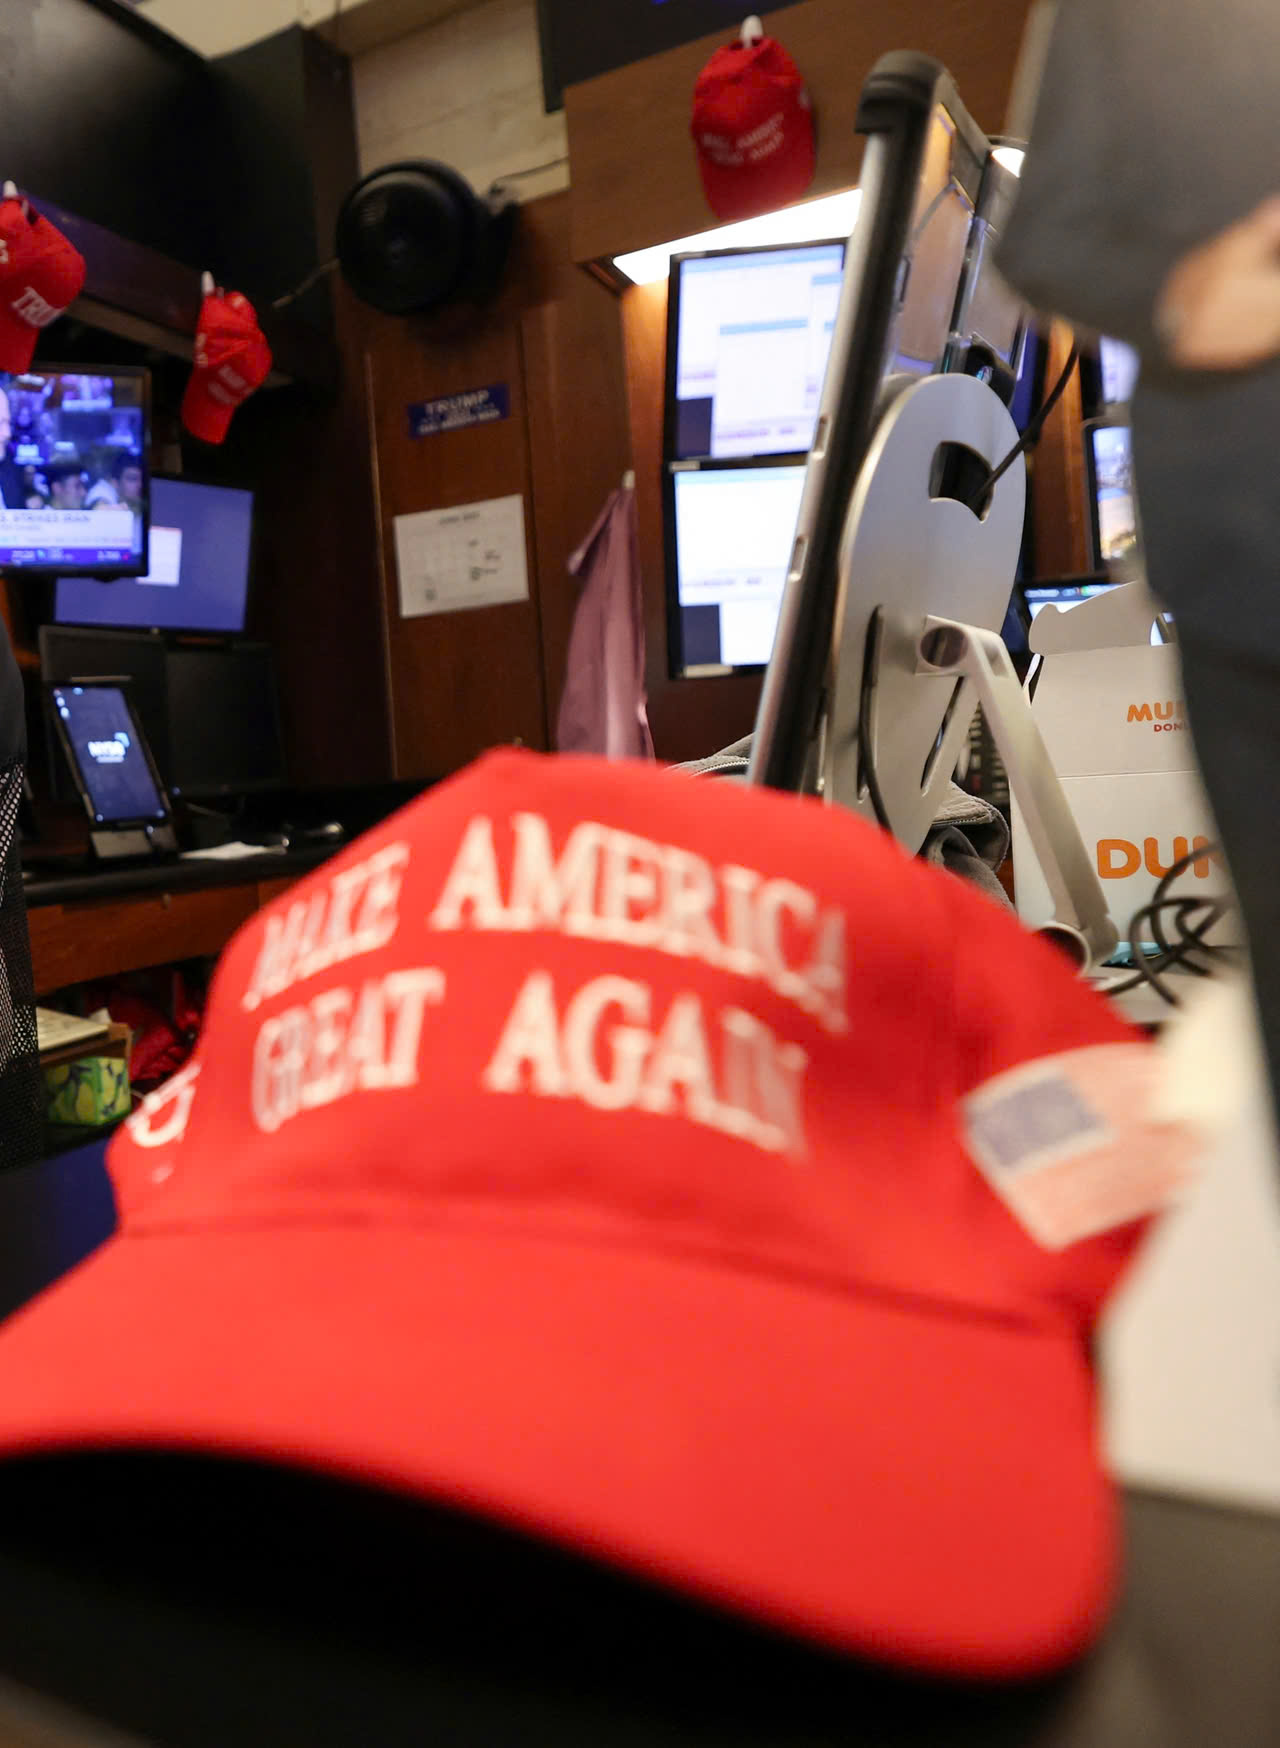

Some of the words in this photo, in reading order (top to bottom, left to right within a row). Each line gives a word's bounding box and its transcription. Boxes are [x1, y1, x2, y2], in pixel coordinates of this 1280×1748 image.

[243, 840, 411, 1012] MAKE
[429, 811, 848, 1034] AMERICA
[251, 966, 447, 1132] GREAT
[482, 970, 810, 1160] AGAIN
